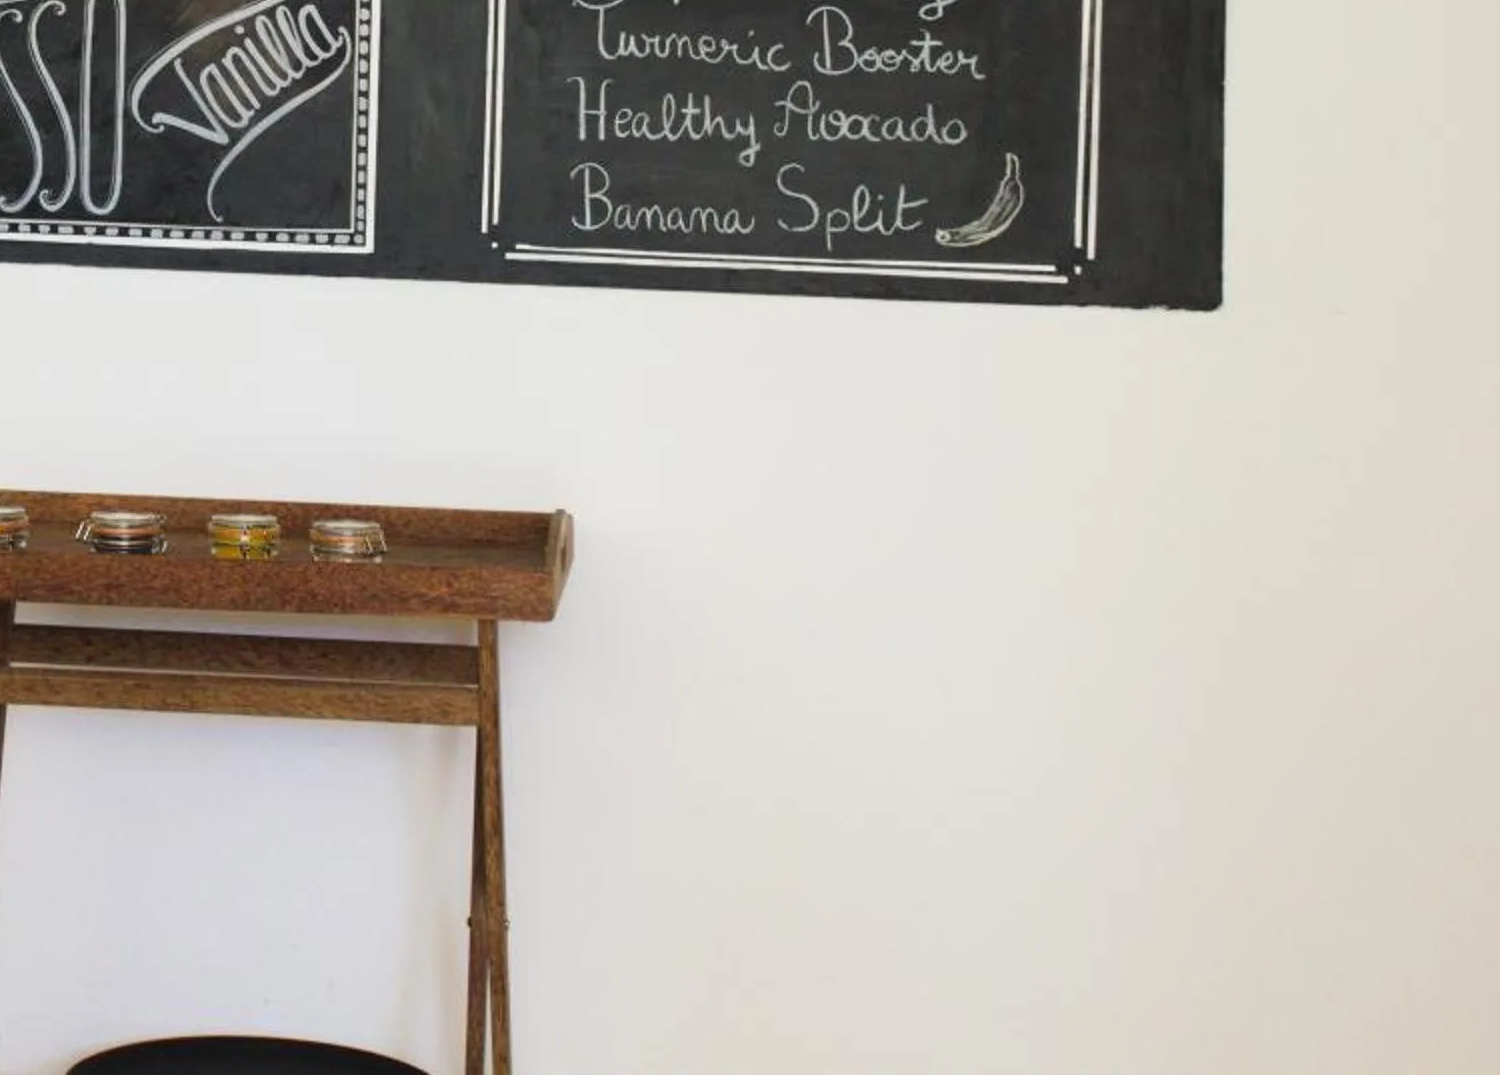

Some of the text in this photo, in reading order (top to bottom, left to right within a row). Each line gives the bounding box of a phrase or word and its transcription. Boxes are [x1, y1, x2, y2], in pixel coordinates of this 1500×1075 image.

[153, 1, 344, 146] Vanilla
[806, 5, 986, 79] Booster
[566, 75, 968, 167] Healthy Avocado
[570, 162, 929, 251] Banana Split
